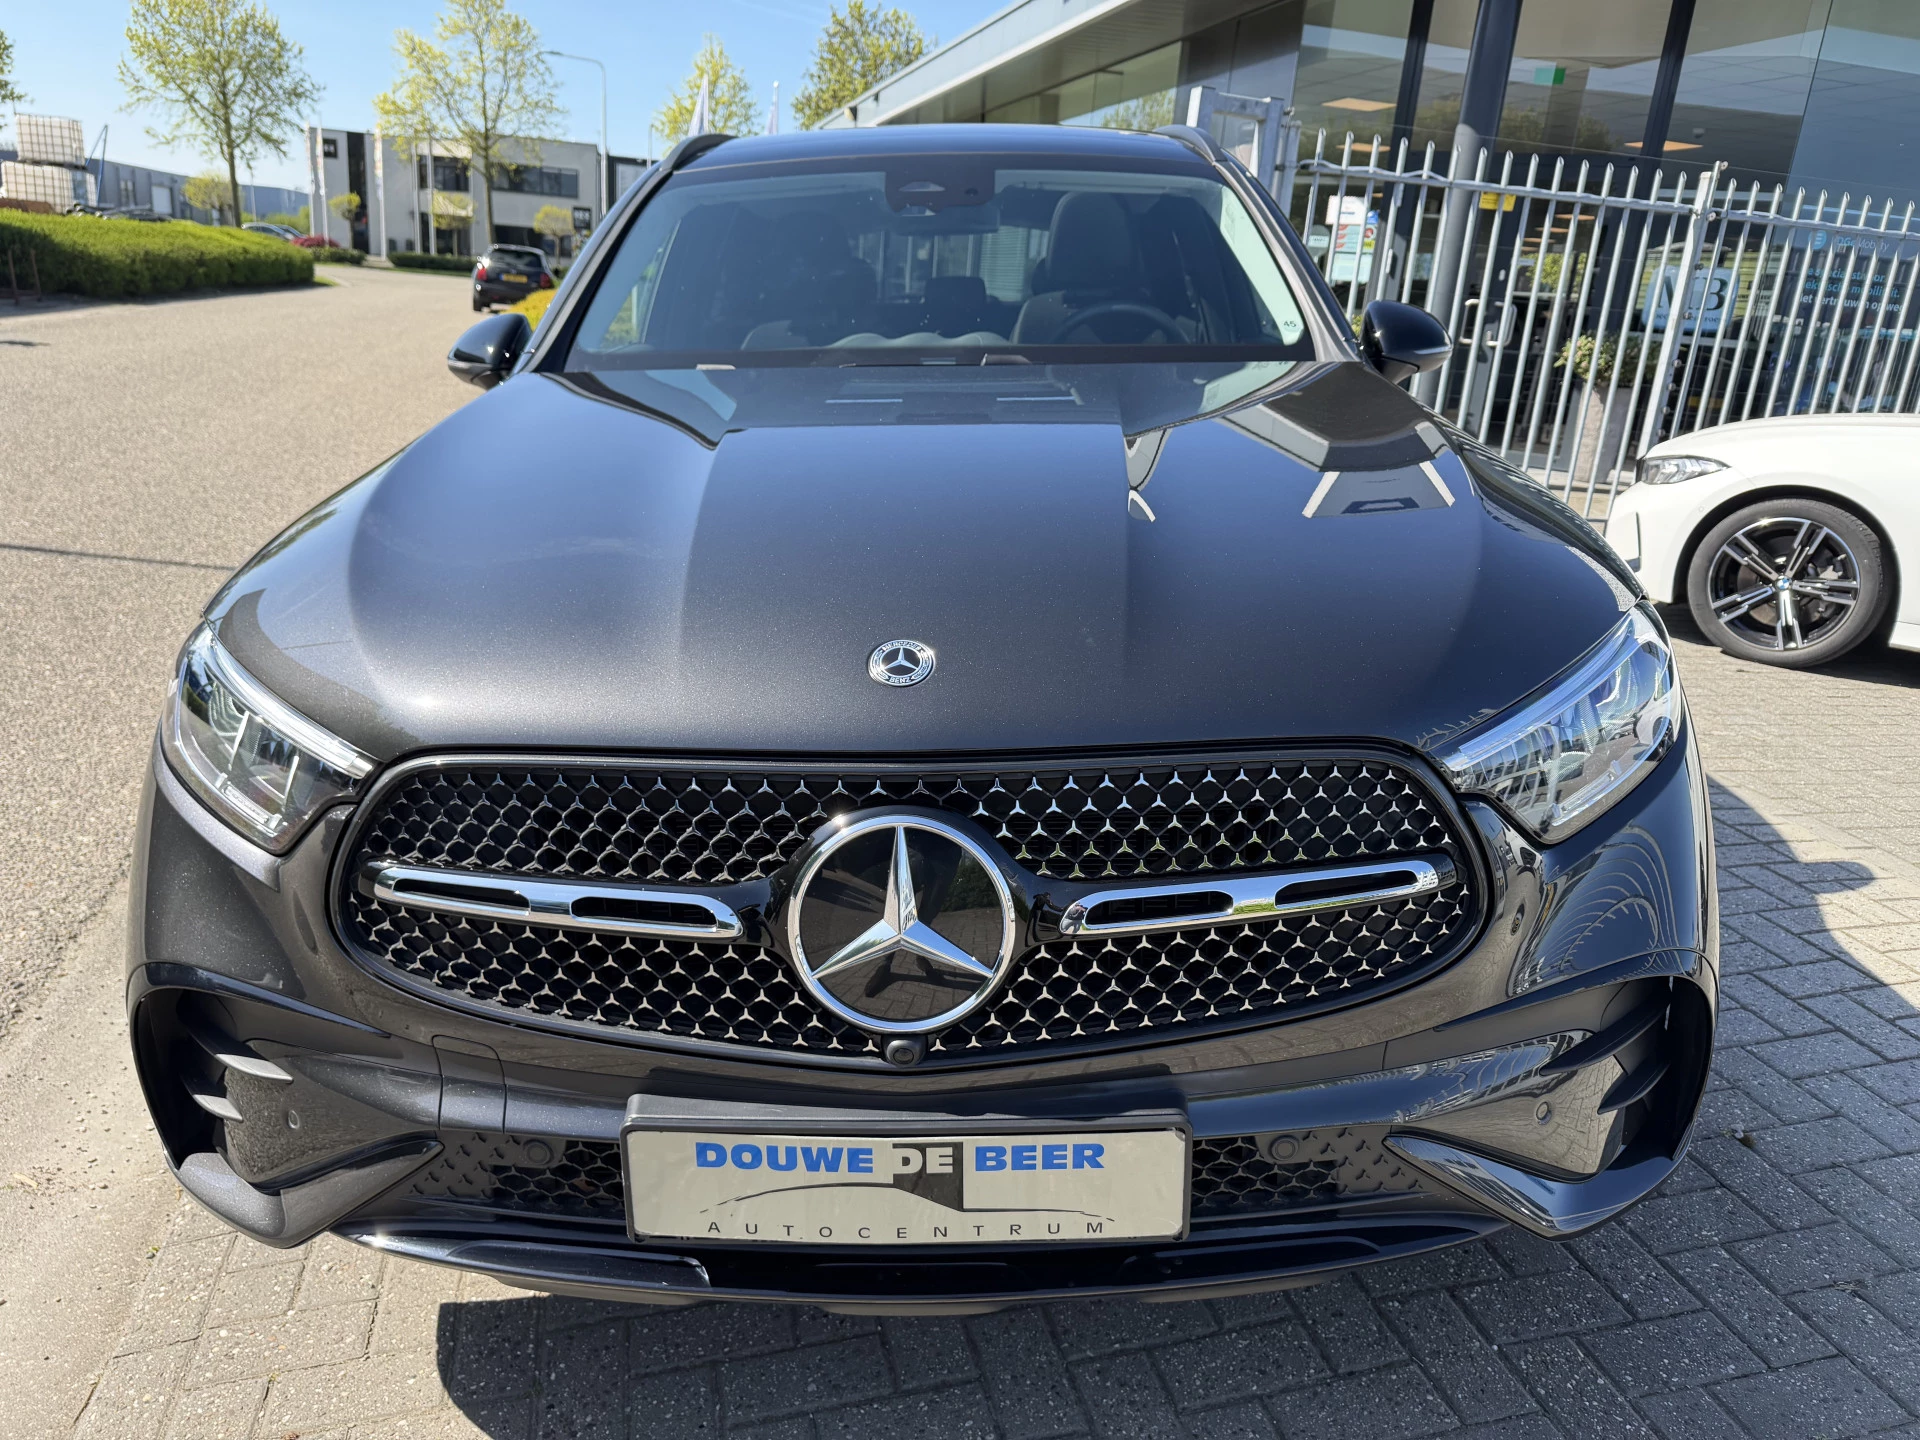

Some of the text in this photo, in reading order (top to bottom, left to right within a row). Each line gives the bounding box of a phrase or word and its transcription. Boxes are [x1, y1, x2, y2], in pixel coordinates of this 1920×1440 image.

[695, 1142, 1105, 1174] DOUWE DE BEER
[707, 1221, 1103, 1239] AUTOCENTRUM
